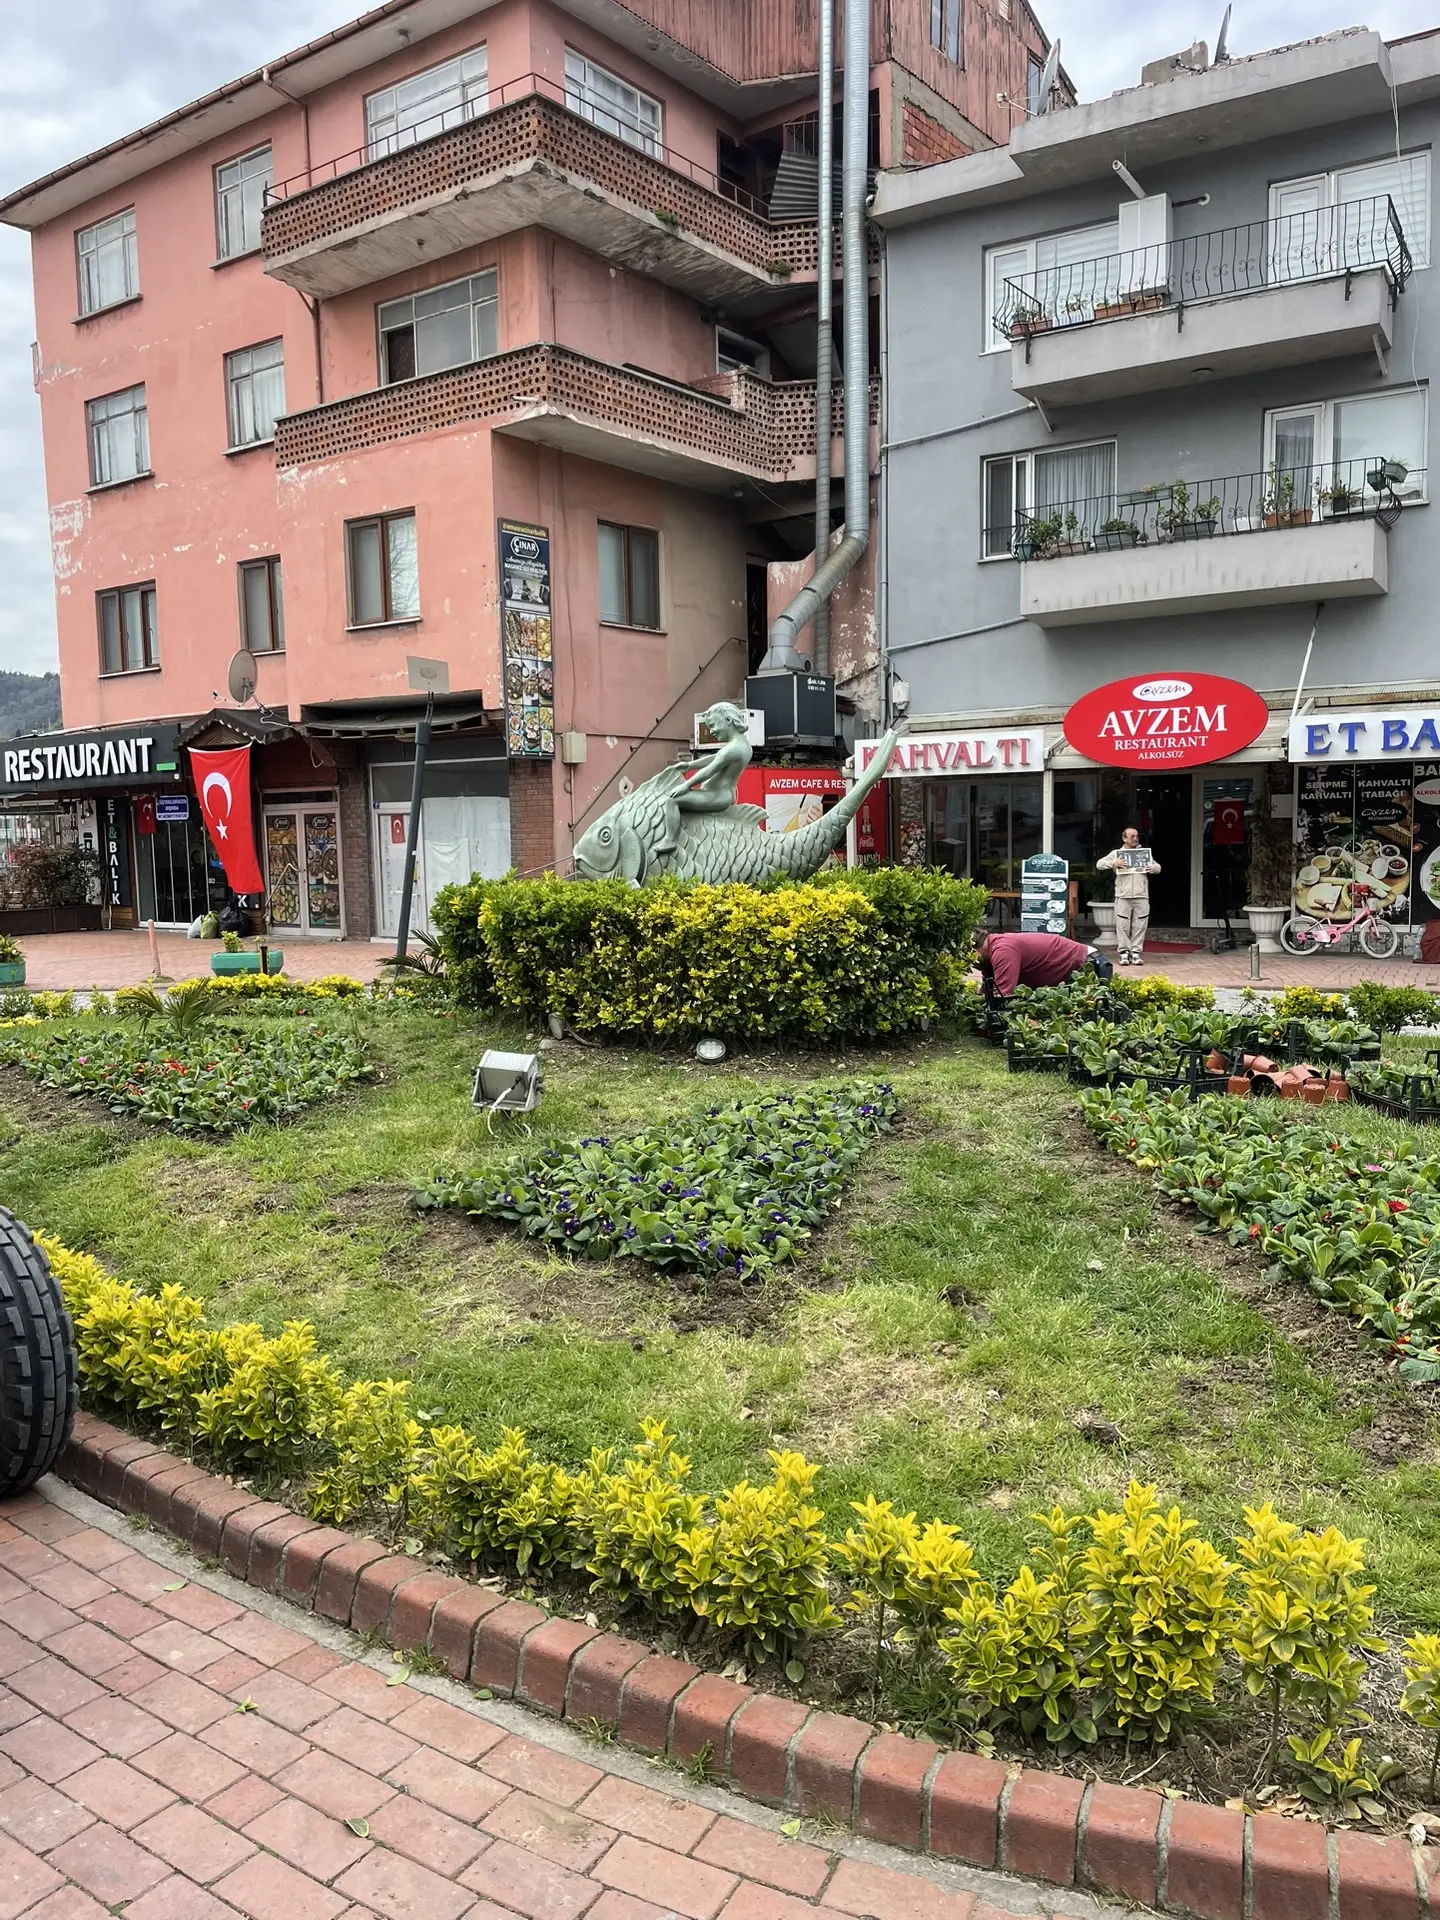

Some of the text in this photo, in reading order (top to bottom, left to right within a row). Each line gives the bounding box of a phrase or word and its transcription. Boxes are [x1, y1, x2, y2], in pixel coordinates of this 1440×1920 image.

[513, 538, 536, 553] ÇINAR
[1097, 704, 1228, 738] AVZEM
[1114, 736, 1208, 750] RESTAURANT
[1305, 722, 1367, 755] ET
[4, 737, 153, 782] RESTAURANT
[1138, 750, 1184, 760] ALKOLSÜZ
[1414, 764, 1440, 776] BA
[770, 779, 799, 788] AVZEM
[801, 779, 822, 788] CAFE
[823, 779, 830, 788] &
[1306, 780, 1348, 789] SERPME
[1358, 779, 1411, 787] KAHVALTI
[1301, 791, 1352, 800] KAHVALTI
[109, 841, 121, 905] BALIK
